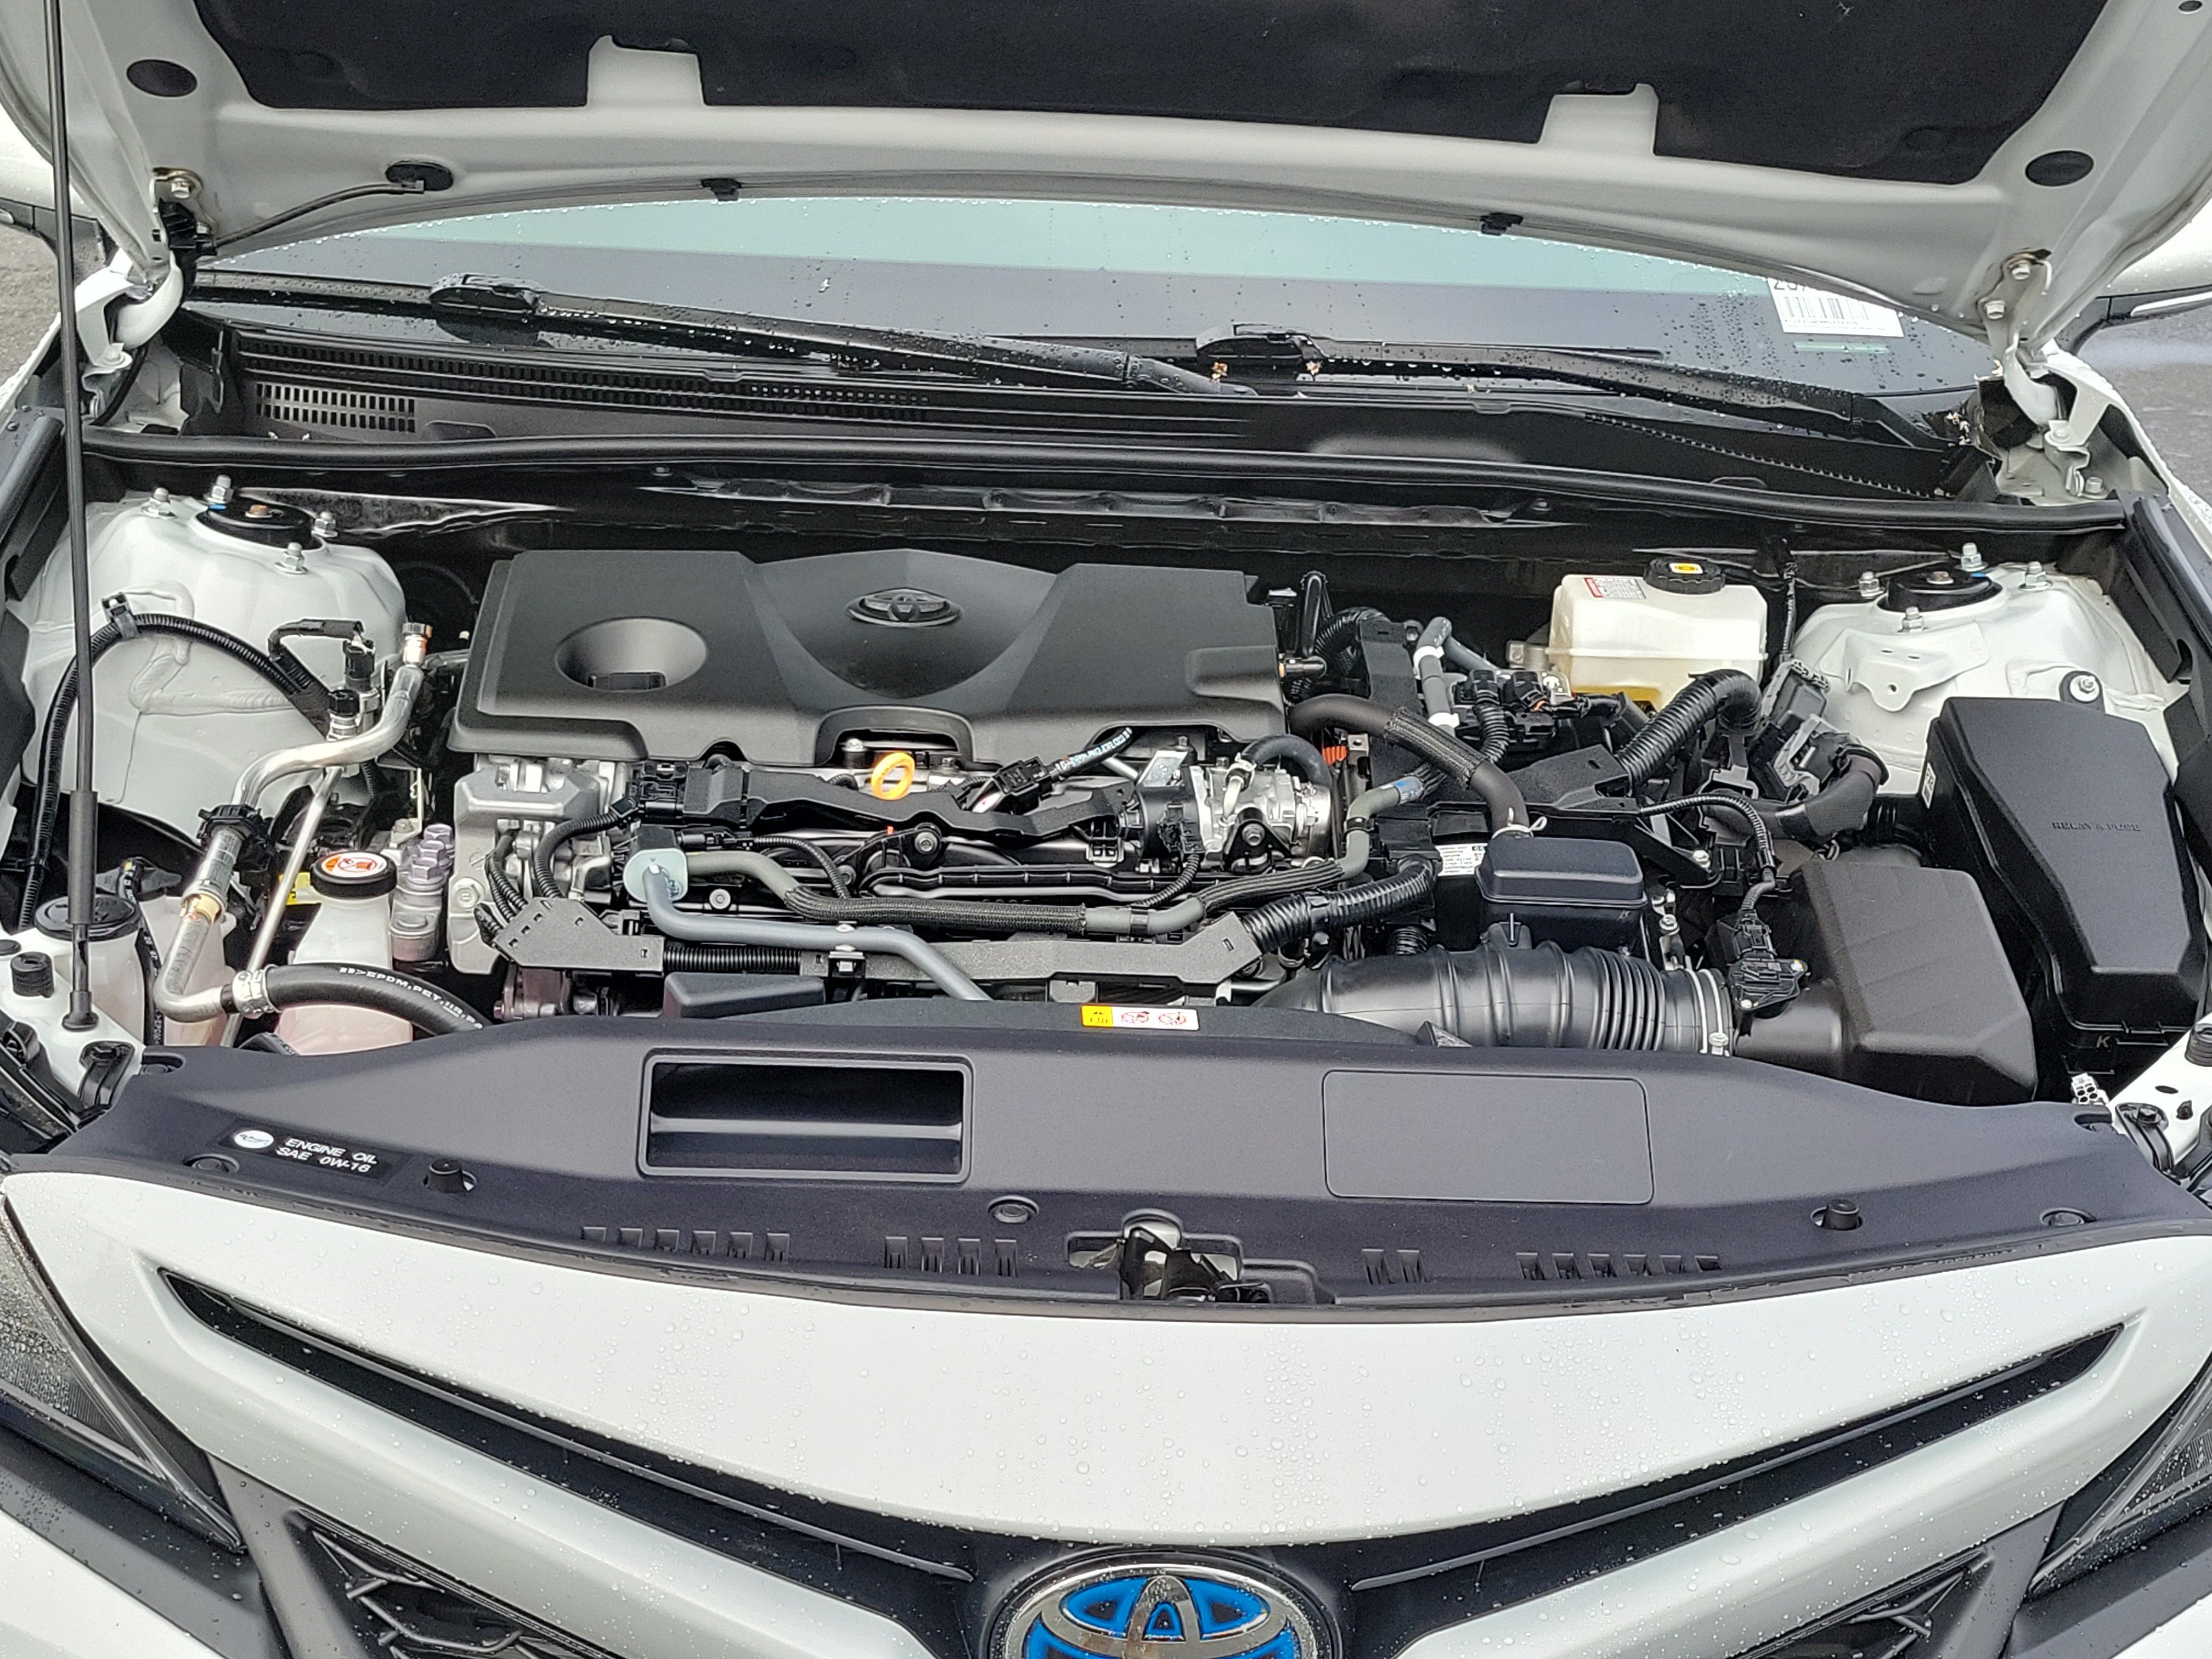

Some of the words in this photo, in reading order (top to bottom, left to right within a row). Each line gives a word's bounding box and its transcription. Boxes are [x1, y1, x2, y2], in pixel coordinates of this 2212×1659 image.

[275, 1147, 313, 1161] SAE
[318, 1156, 371, 1173] 0W-16
[285, 1138, 347, 1157] ENGINE
[352, 1152, 378, 1165] OIL
